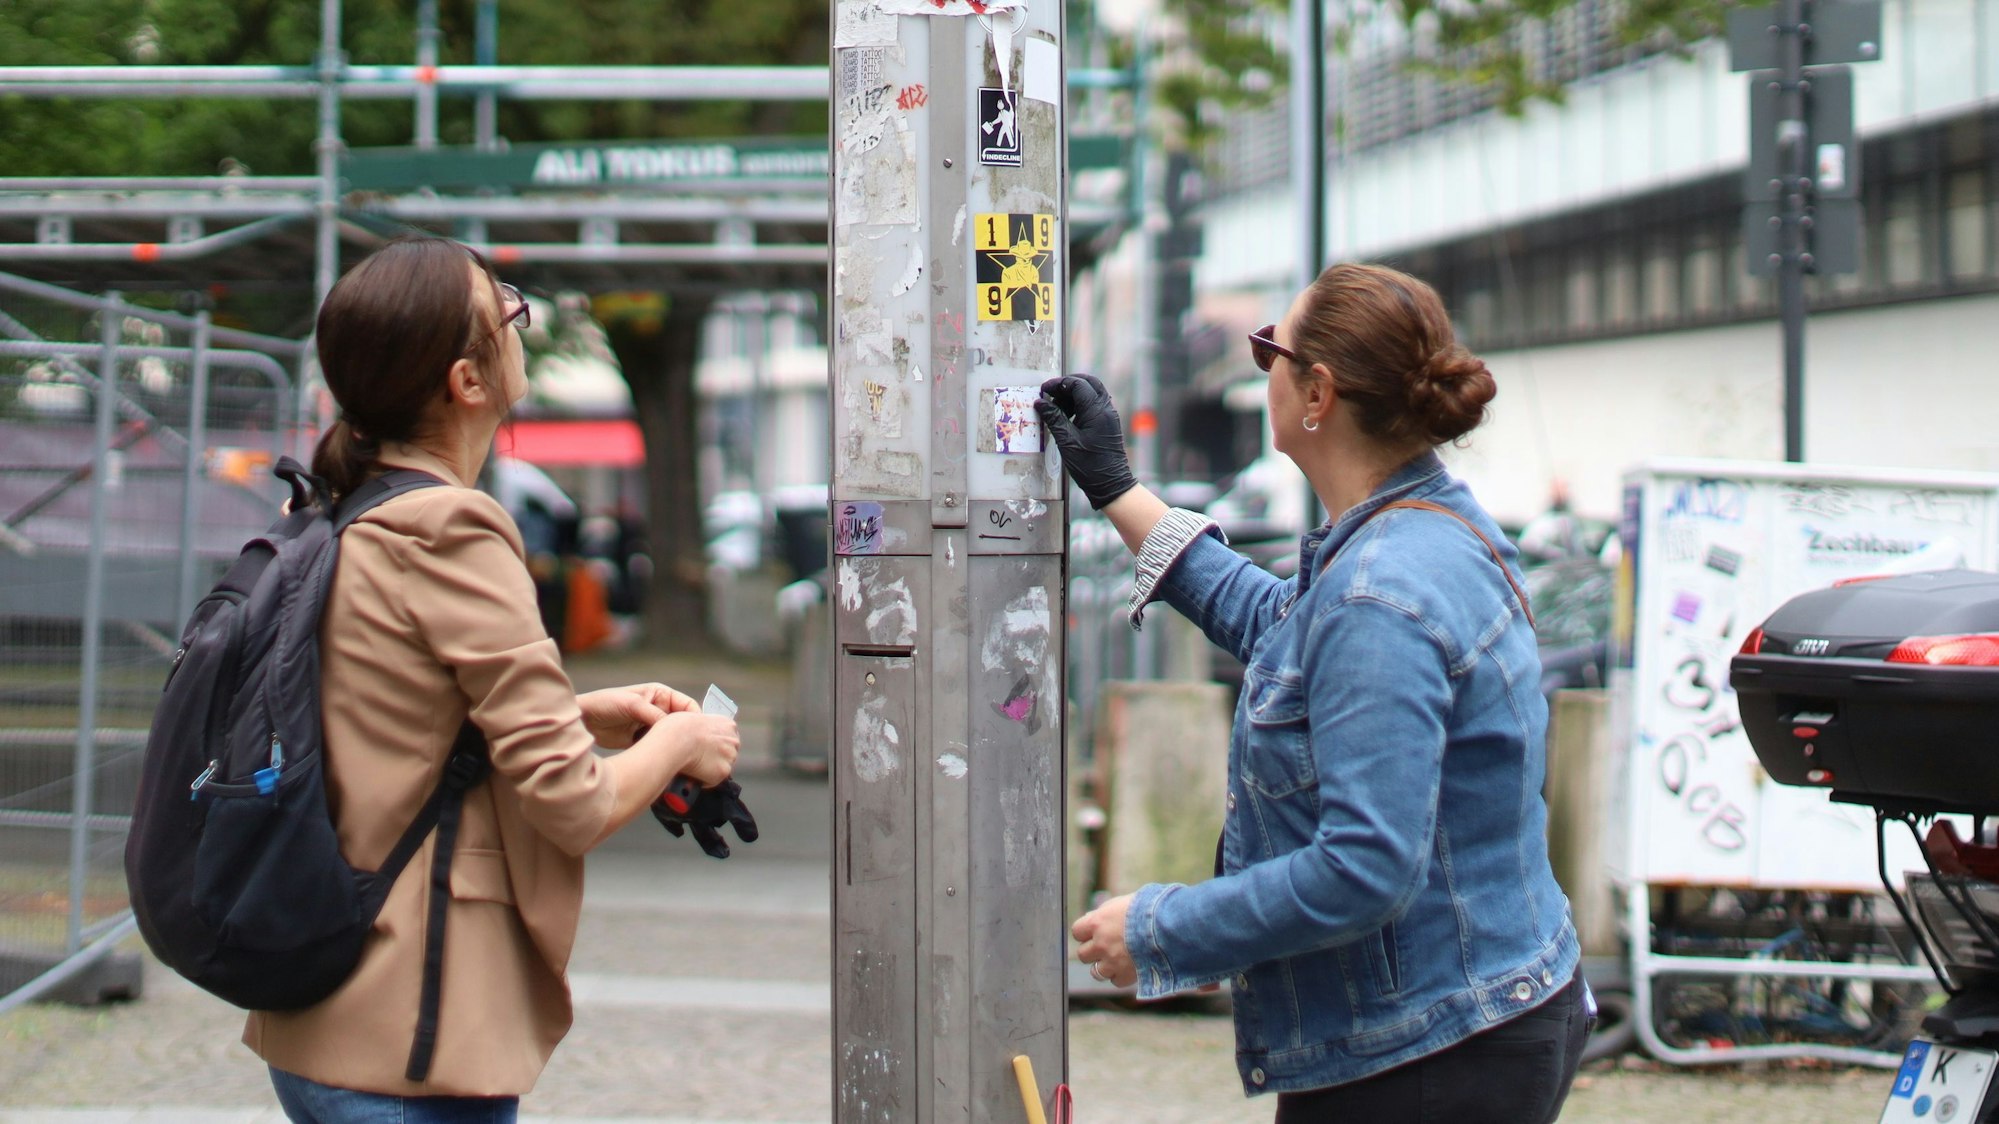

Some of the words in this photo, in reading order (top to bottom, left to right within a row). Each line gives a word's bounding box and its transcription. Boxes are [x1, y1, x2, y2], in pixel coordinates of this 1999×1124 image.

[987, 217, 997, 247] 1
[1040, 217, 1049, 247] 9
[987, 285, 1002, 316] 9
[1042, 285, 1050, 316] 9
[1931, 1050, 1957, 1084] K
[1901, 1076, 1913, 1092] D
